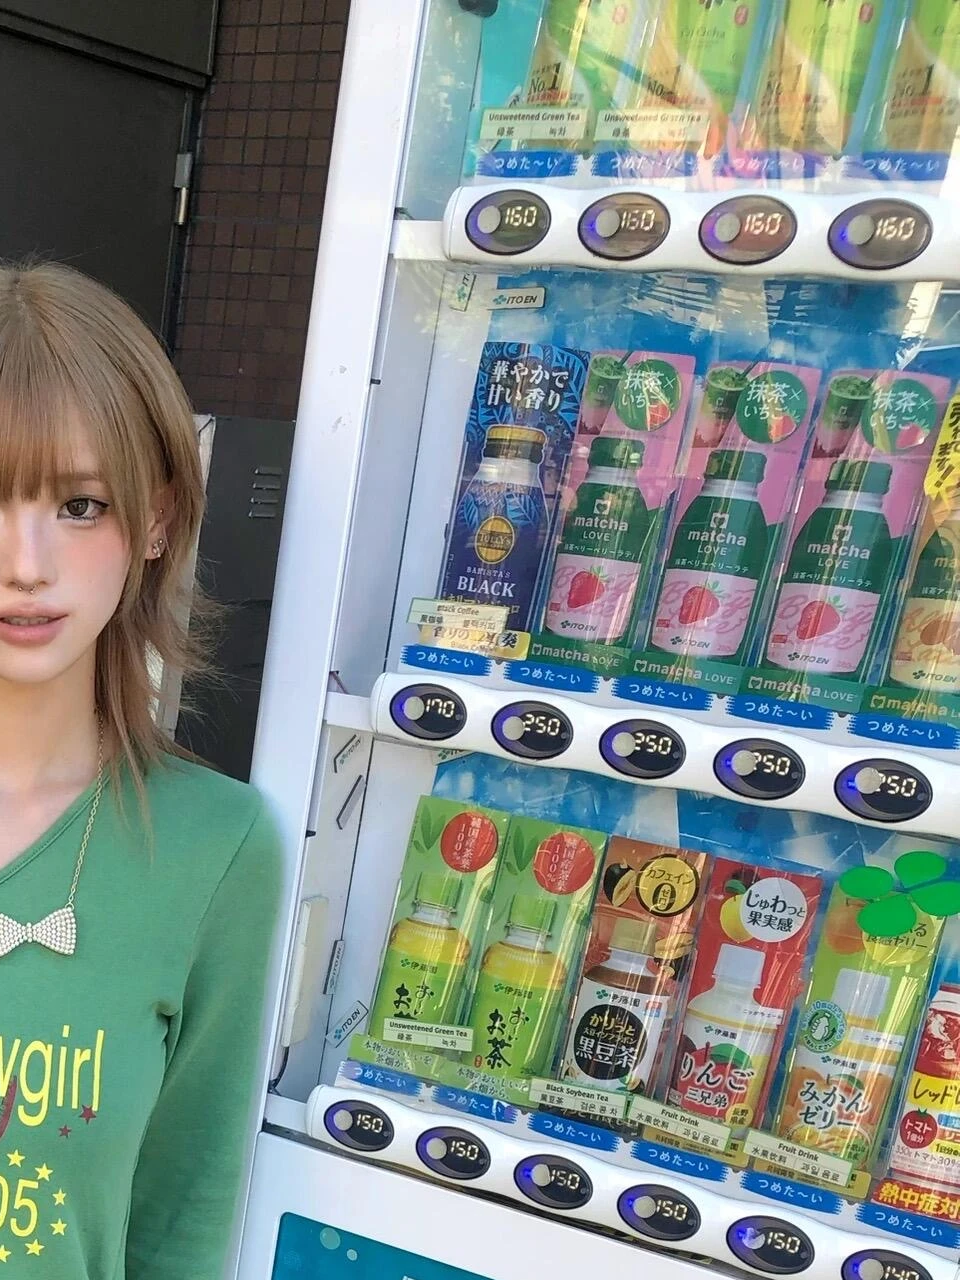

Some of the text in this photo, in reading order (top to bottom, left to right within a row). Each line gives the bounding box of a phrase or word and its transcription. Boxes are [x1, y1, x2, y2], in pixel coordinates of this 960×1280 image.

[489, 113, 580, 122] Unsweetened Green Tea
[504, 206, 537, 227] 160
[620, 209, 654, 232] 160
[743, 212, 782, 236] 160
[875, 216, 915, 240] 160
[491, 360, 569, 388] 華やかで
[487, 383, 561, 412] 甘い香り
[574, 516, 628, 531] matcha
[583, 531, 610, 541] LOVE
[688, 530, 747, 546] matcha
[698, 545, 727, 556] LOVE
[807, 542, 870, 560] matcha
[818, 558, 849, 570] LOVE
[457, 576, 516, 597] BLACK
[542, 646, 620, 667] matcha LOVE
[648, 662, 734, 685] matcha LOVE
[763, 680, 856, 702] matcha LOVE
[424, 698, 455, 718] 170
[887, 698, 948, 716] matcha
[522, 714, 560, 735] 250
[634, 732, 672, 755] 250
[645, 866, 695, 885] カフェイン
[746, 891, 805, 918] じゅわっと
[746, 911, 794, 932] 果実感
[389, 1021, 468, 1038] Unsweetened Green Tea
[590, 1013, 635, 1036] かりっと
[714, 1028, 738, 1040] 伊藤園
[485, 1009, 512, 1069] お茶
[576, 1036, 637, 1068] 黒豆茶
[681, 1054, 754, 1091] りんご
[546, 1084, 609, 1102] Black Soybean Tea
[685, 1087, 728, 1108] 三兄弟
[799, 1081, 870, 1114] みかん
[356, 1113, 383, 1132] 150
[661, 1109, 700, 1127] Fruit Drink
[799, 1104, 857, 1129] ゼリー
[905, 1119, 933, 1134] トマト
[449, 1142, 479, 1161] 150
[778, 1142, 819, 1162] Fruit Drink
[551, 1169, 580, 1190] 150
[656, 1200, 688, 1221] 150
[766, 1232, 800, 1253] 150
